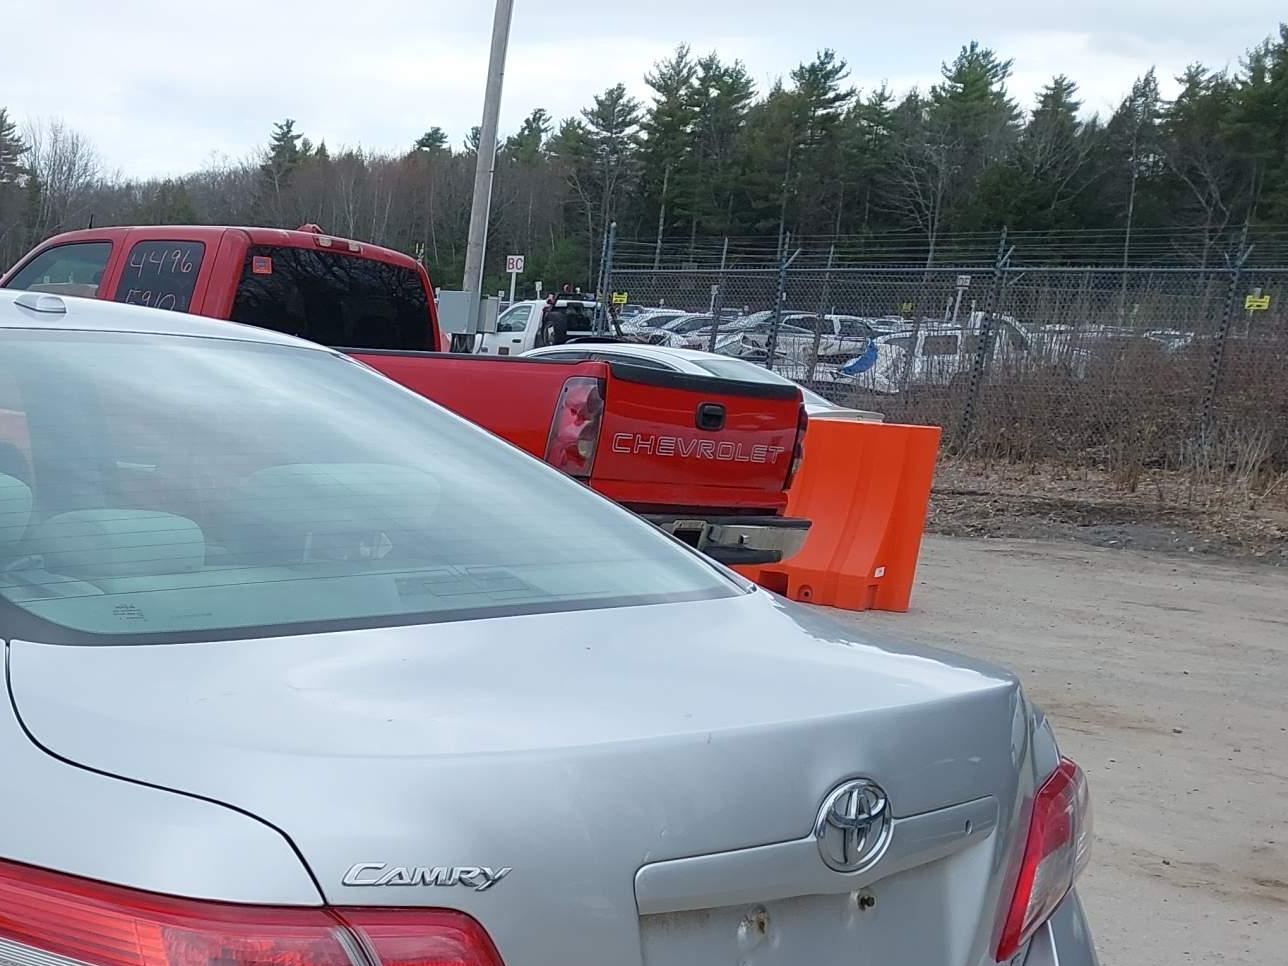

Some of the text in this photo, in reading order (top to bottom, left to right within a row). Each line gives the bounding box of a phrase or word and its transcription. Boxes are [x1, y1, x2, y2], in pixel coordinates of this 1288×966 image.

[129, 249, 194, 279] 4496
[507, 257, 524, 271] BC
[612, 432, 785, 465] CHEVROLET
[341, 861, 513, 893] CAMRY
